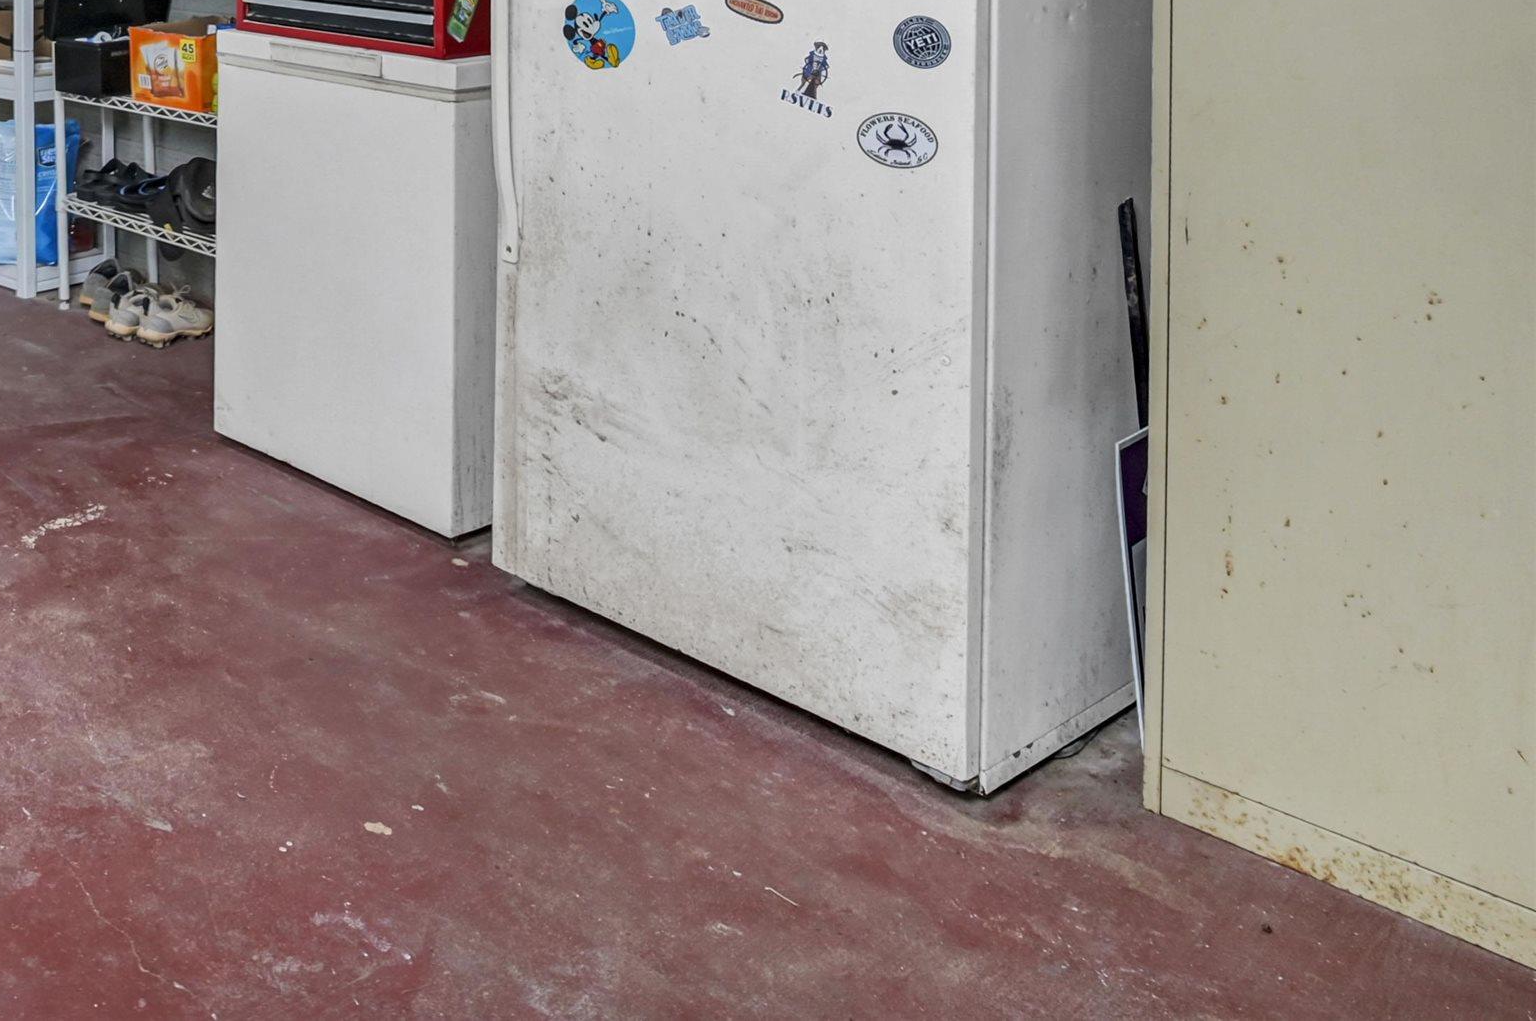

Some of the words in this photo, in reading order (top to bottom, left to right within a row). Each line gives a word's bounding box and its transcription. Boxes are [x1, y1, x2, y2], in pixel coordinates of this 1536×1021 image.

[181, 43, 194, 54] 45
[905, 32, 938, 50] YETI
[860, 115, 896, 139] FLOWERS
[897, 116, 935, 144] SEAFOOD
